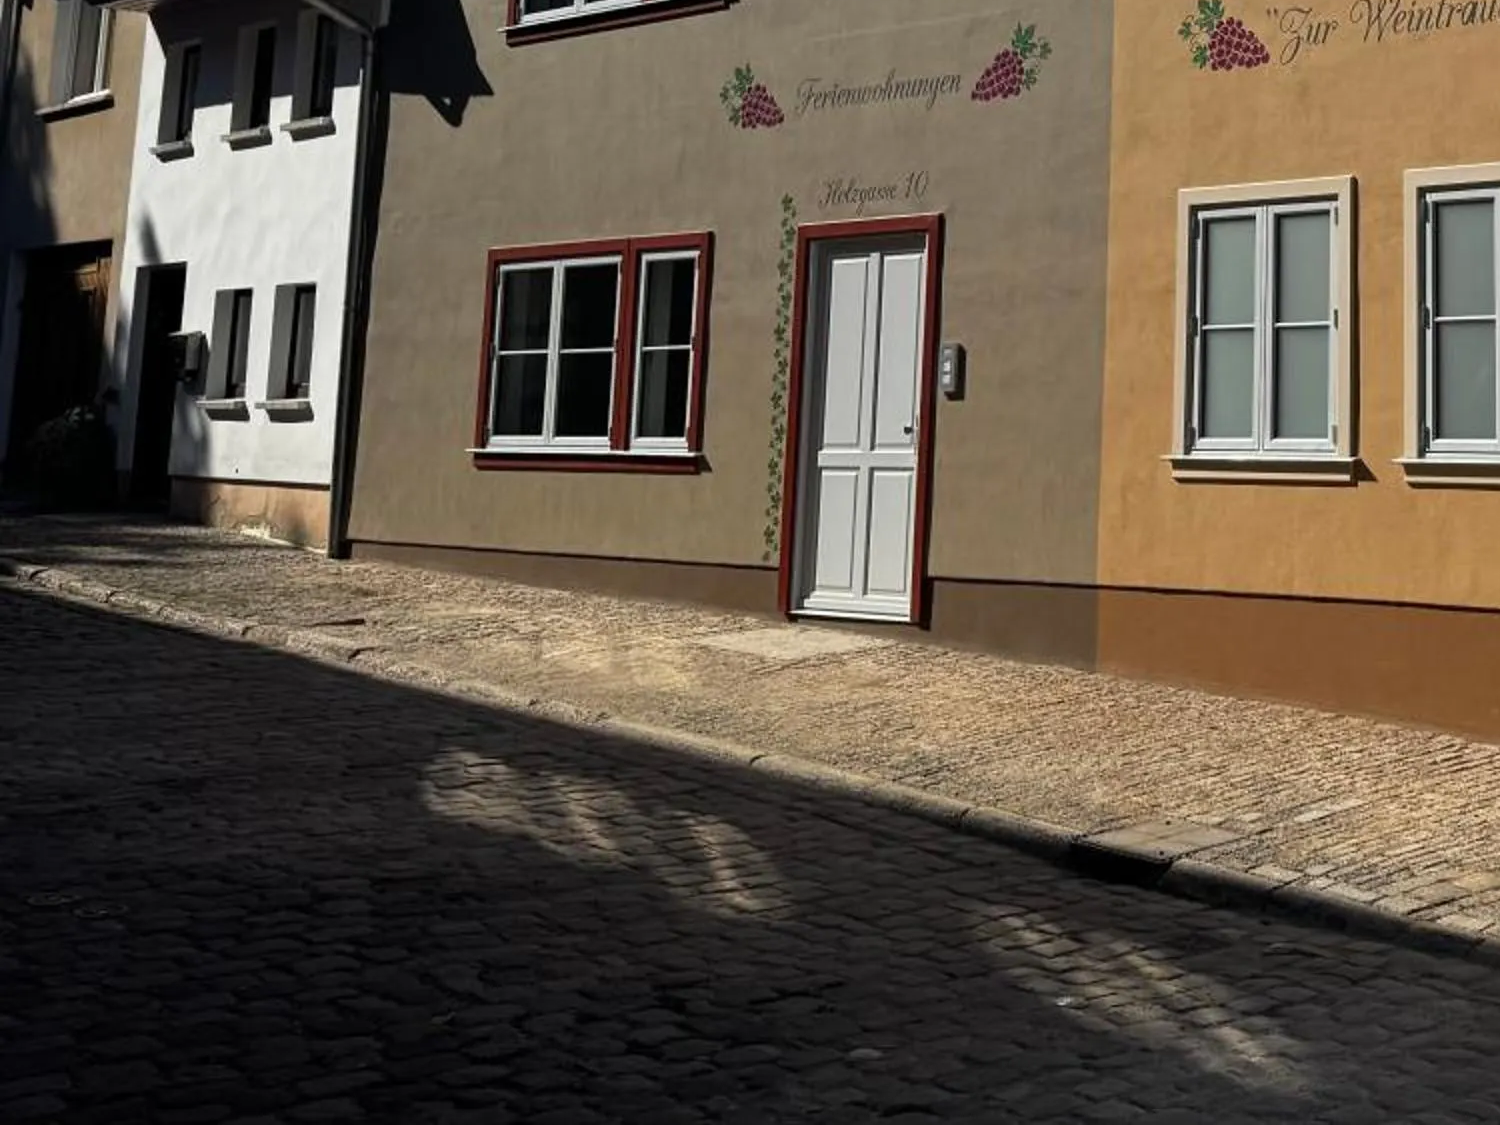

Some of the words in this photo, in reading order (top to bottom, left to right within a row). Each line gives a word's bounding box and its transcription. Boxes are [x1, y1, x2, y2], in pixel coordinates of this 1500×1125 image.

[795, 67, 961, 115] Ferienwohnungen
[818, 176, 897, 216] Holzgasse
[904, 170, 930, 202] 10
